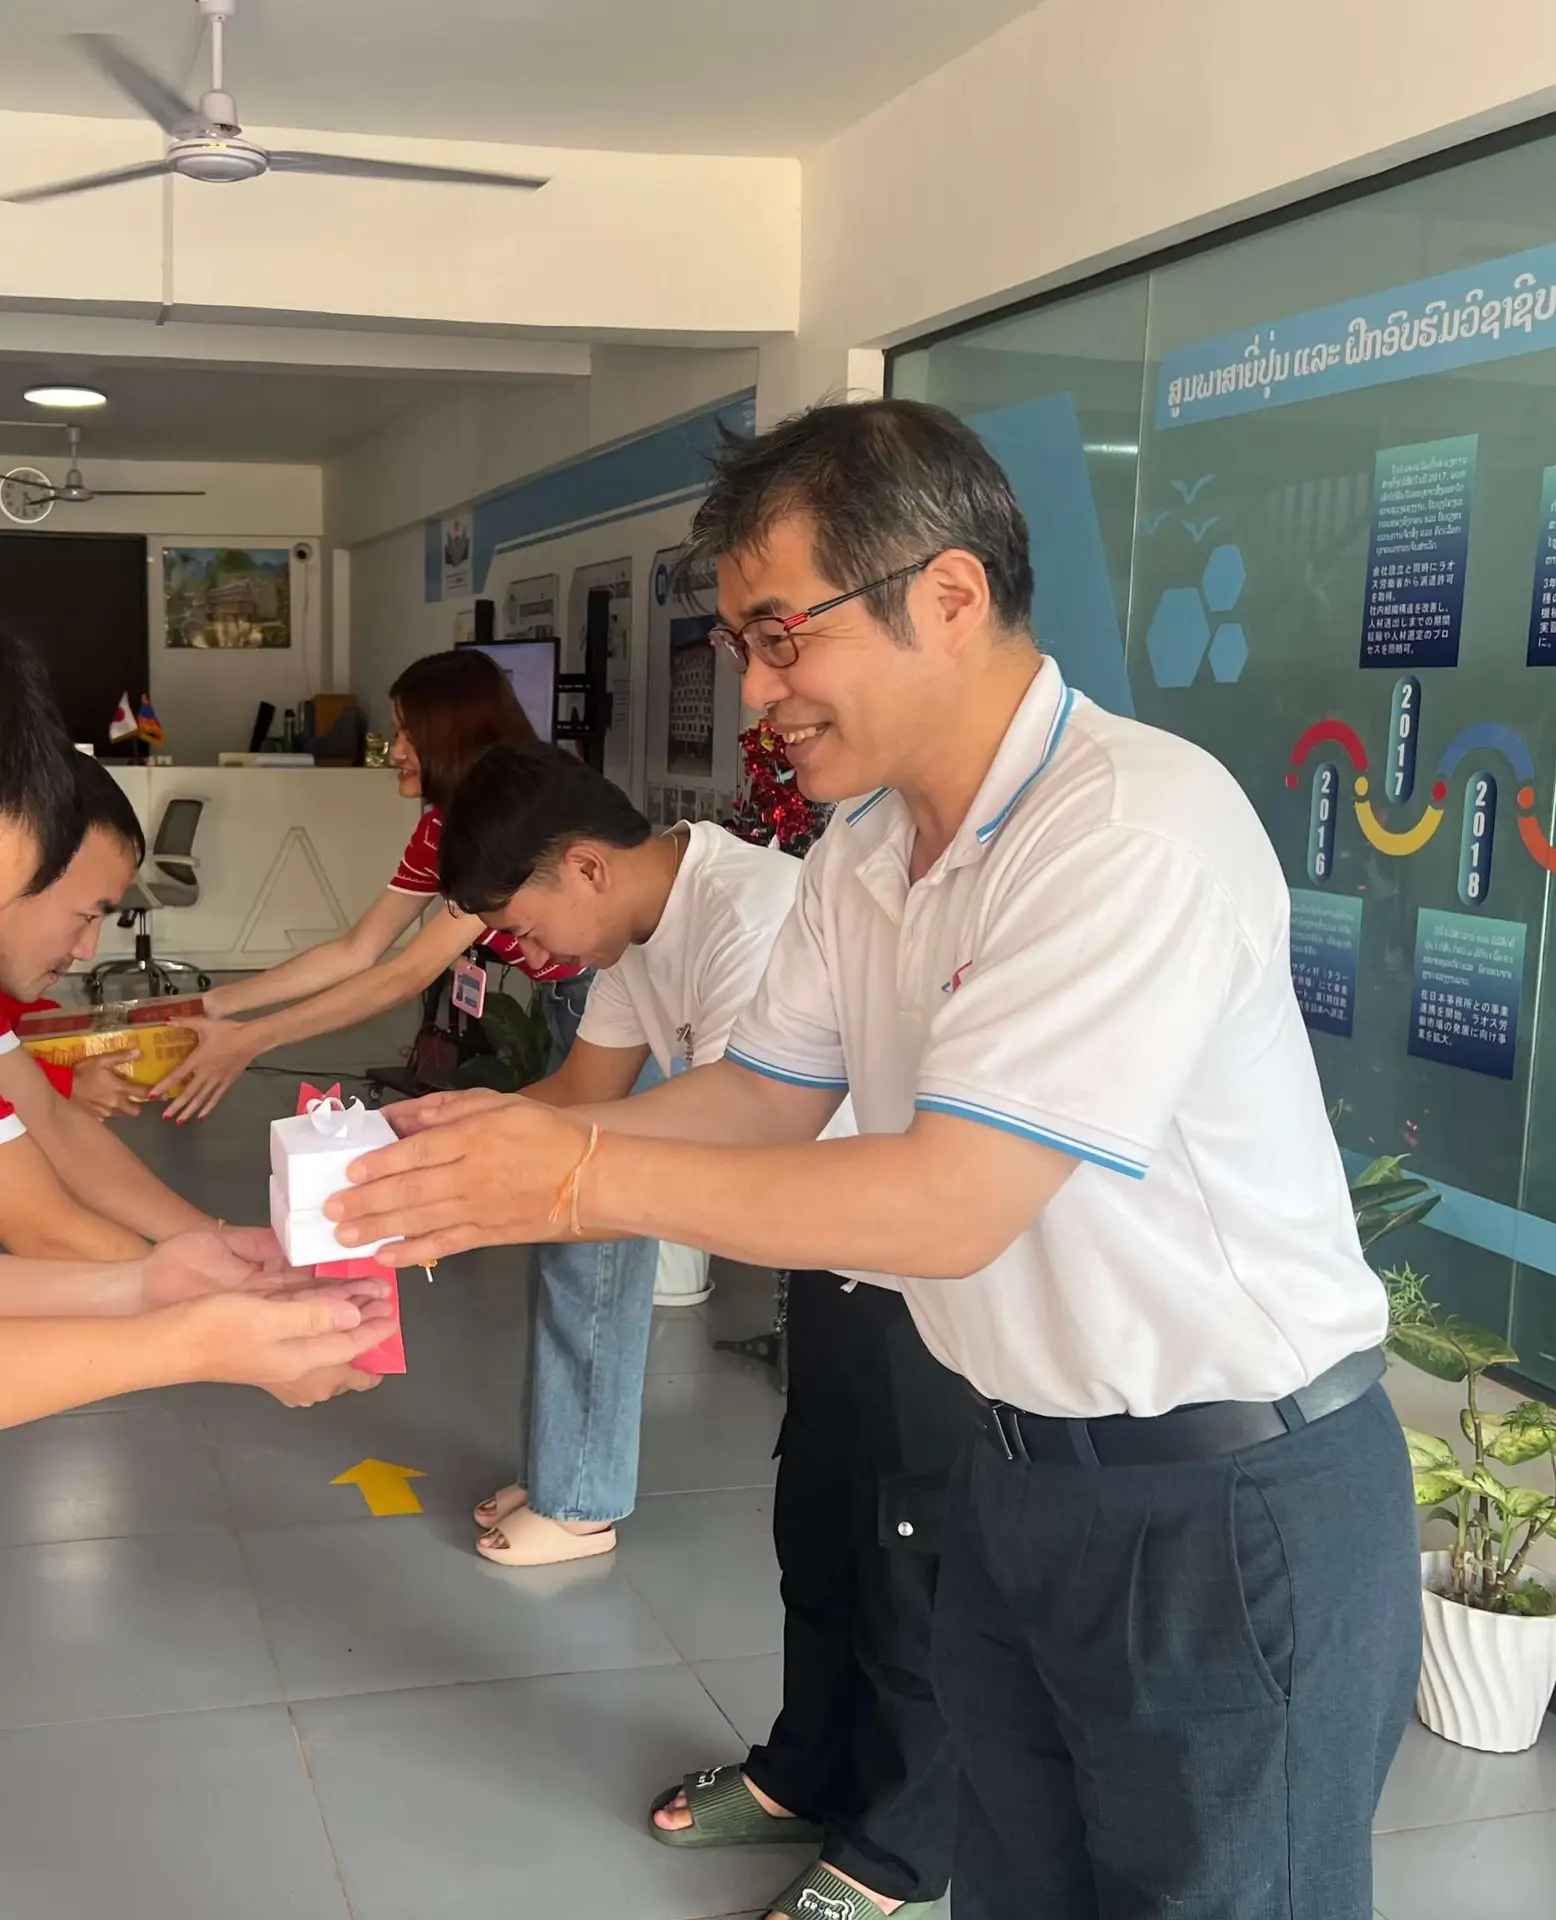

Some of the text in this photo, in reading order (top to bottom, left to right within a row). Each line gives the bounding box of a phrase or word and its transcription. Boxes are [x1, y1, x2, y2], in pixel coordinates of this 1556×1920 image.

[1293, 343, 1341, 376] ແລະ
[1395, 684, 1412, 796] 2017
[1315, 771, 1331, 876] 2016
[1467, 780, 1488, 898] 2018
